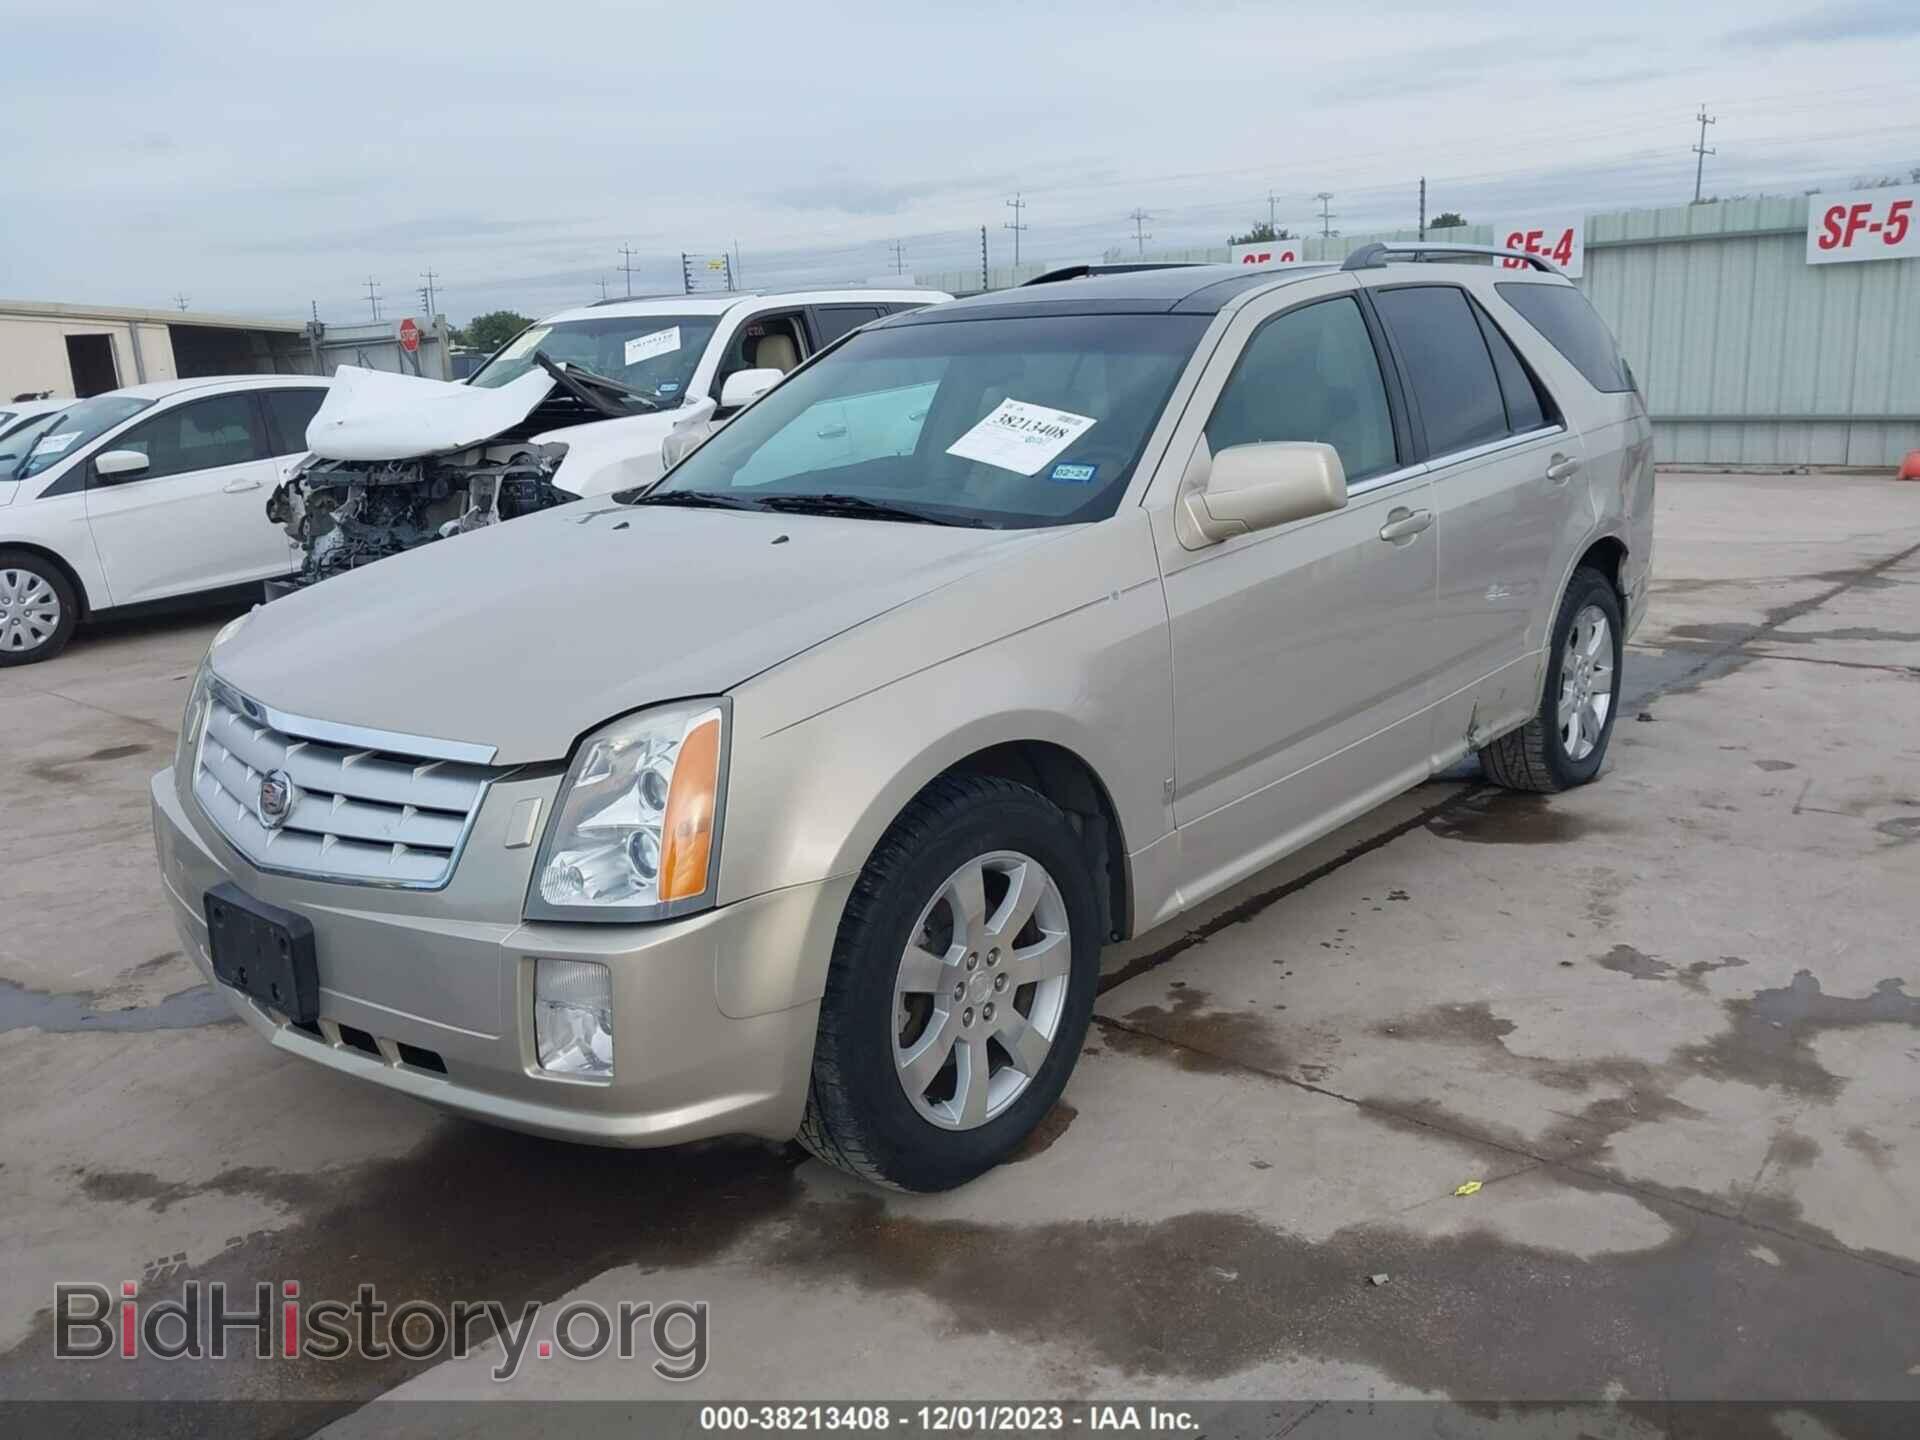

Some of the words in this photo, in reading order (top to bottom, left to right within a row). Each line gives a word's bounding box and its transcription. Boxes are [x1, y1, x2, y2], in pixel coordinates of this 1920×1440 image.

[1818, 200, 1914, 250] SF-5
[1503, 228, 1574, 270] SF-4
[993, 413, 1070, 440] 38213408
